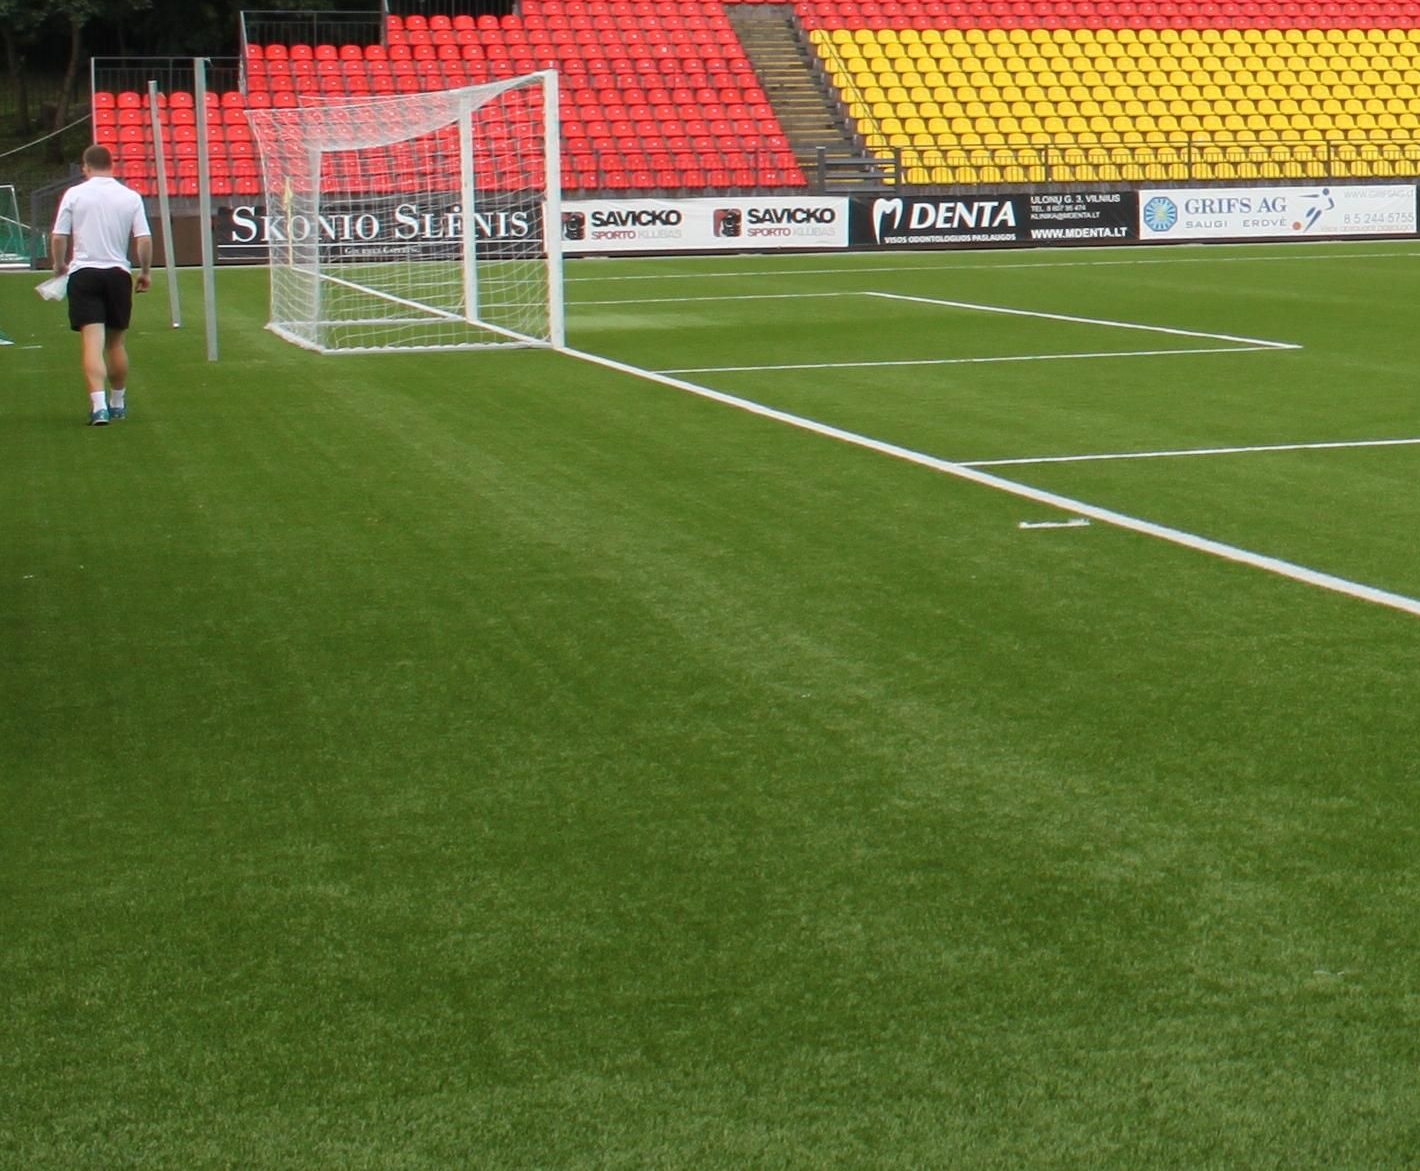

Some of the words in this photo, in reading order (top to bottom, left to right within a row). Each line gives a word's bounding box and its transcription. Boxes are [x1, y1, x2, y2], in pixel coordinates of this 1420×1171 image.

[1085, 194, 1120, 203] VILNIUS
[1185, 197, 1251, 215] GRIFS
[1258, 196, 1287, 213] AG
[591, 209, 682, 228] SAVICKO
[747, 208, 836, 225] SAVICKO
[1186, 219, 1227, 229] SAUGI
[1243, 216, 1287, 228] ERDVĖ
[1364, 213, 1384, 223] 244
[1388, 213, 1414, 223] 5755
[231, 205, 380, 243] SKONIO
[591, 230, 636, 240] SPORTO
[637, 228, 682, 239] KLUBAS
[747, 227, 791, 238] SPORTO
[884, 236, 907, 244] VISOS
[972, 233, 1016, 242] PASLAUGOS
[1030, 227, 1128, 239] WWW.MDENTA.LT
